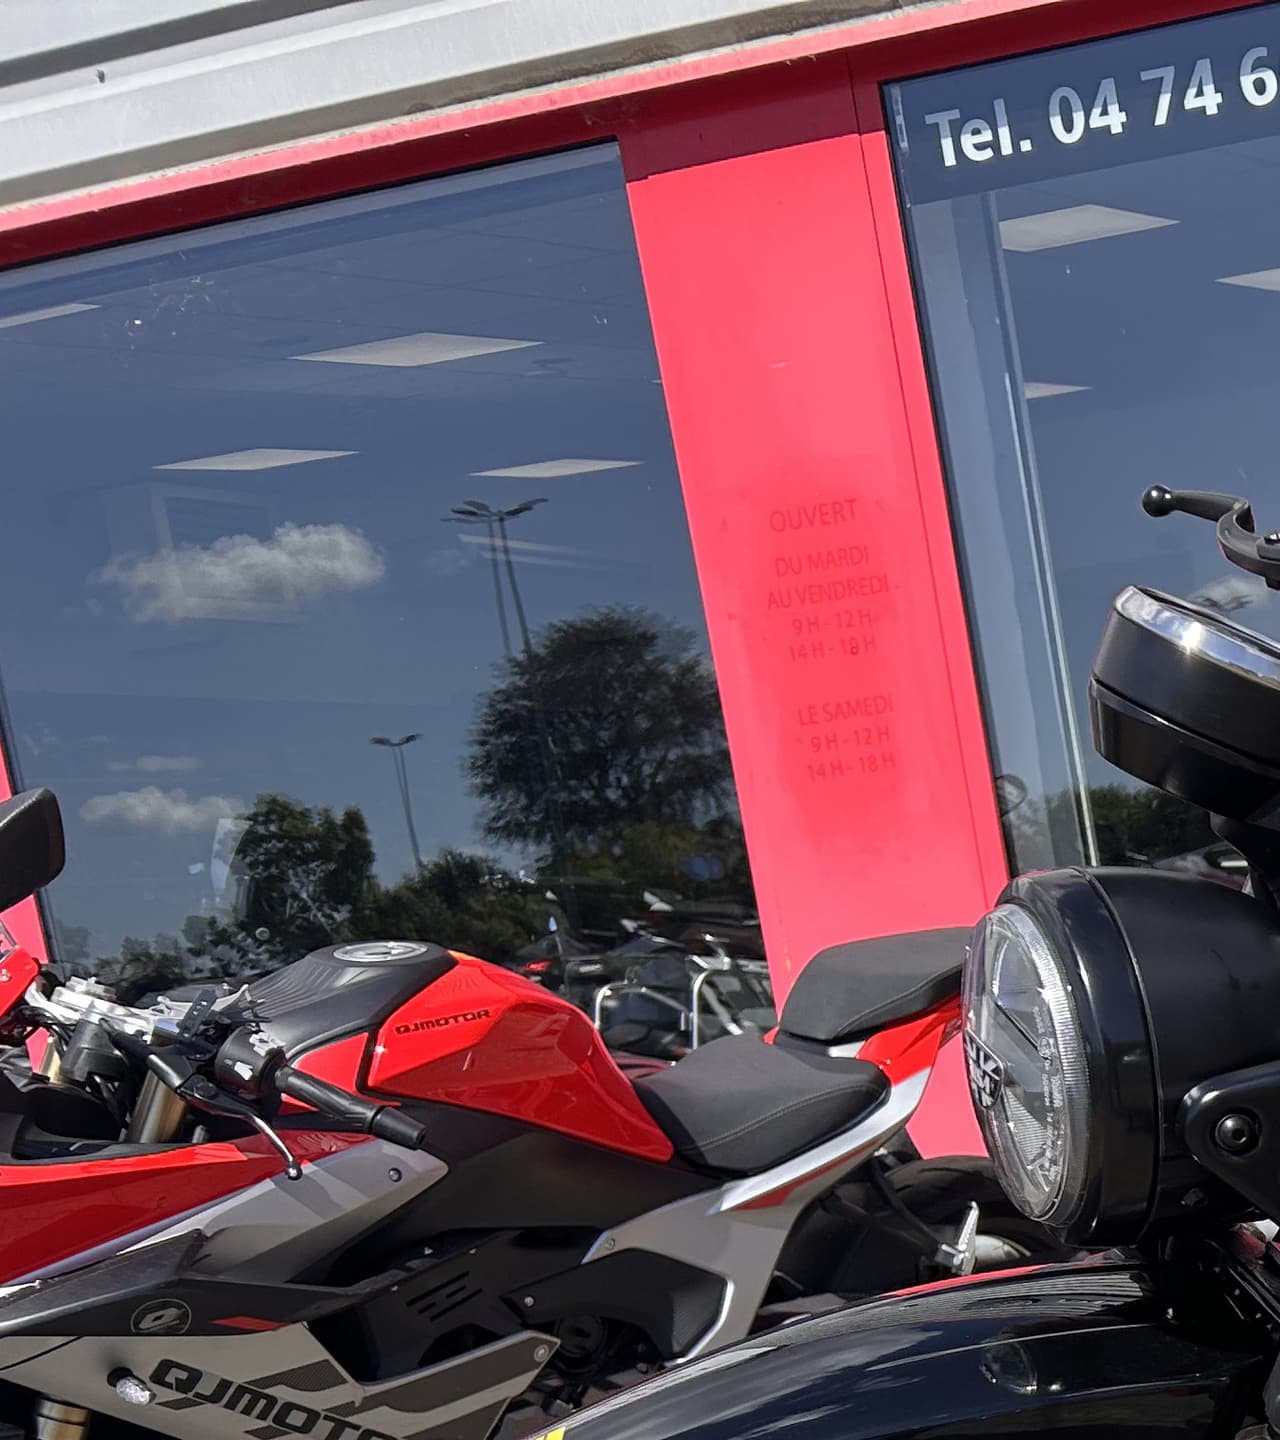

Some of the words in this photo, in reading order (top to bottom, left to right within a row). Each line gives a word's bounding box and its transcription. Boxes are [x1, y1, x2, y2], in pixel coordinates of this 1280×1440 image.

[925, 97, 1032, 167] Tel.
[1048, 78, 1127, 146] 04
[1140, 58, 1223, 127] 74
[769, 498, 857, 533] OUVERT
[775, 557, 803, 578] DU
[808, 546, 870, 572] MARDI
[767, 590, 792, 610] AU
[795, 573, 889, 606] VENDREDI
[797, 704, 819, 726] LE
[822, 695, 894, 722] SAMEDI
[395, 1009, 490, 1035] QJMOTOR
